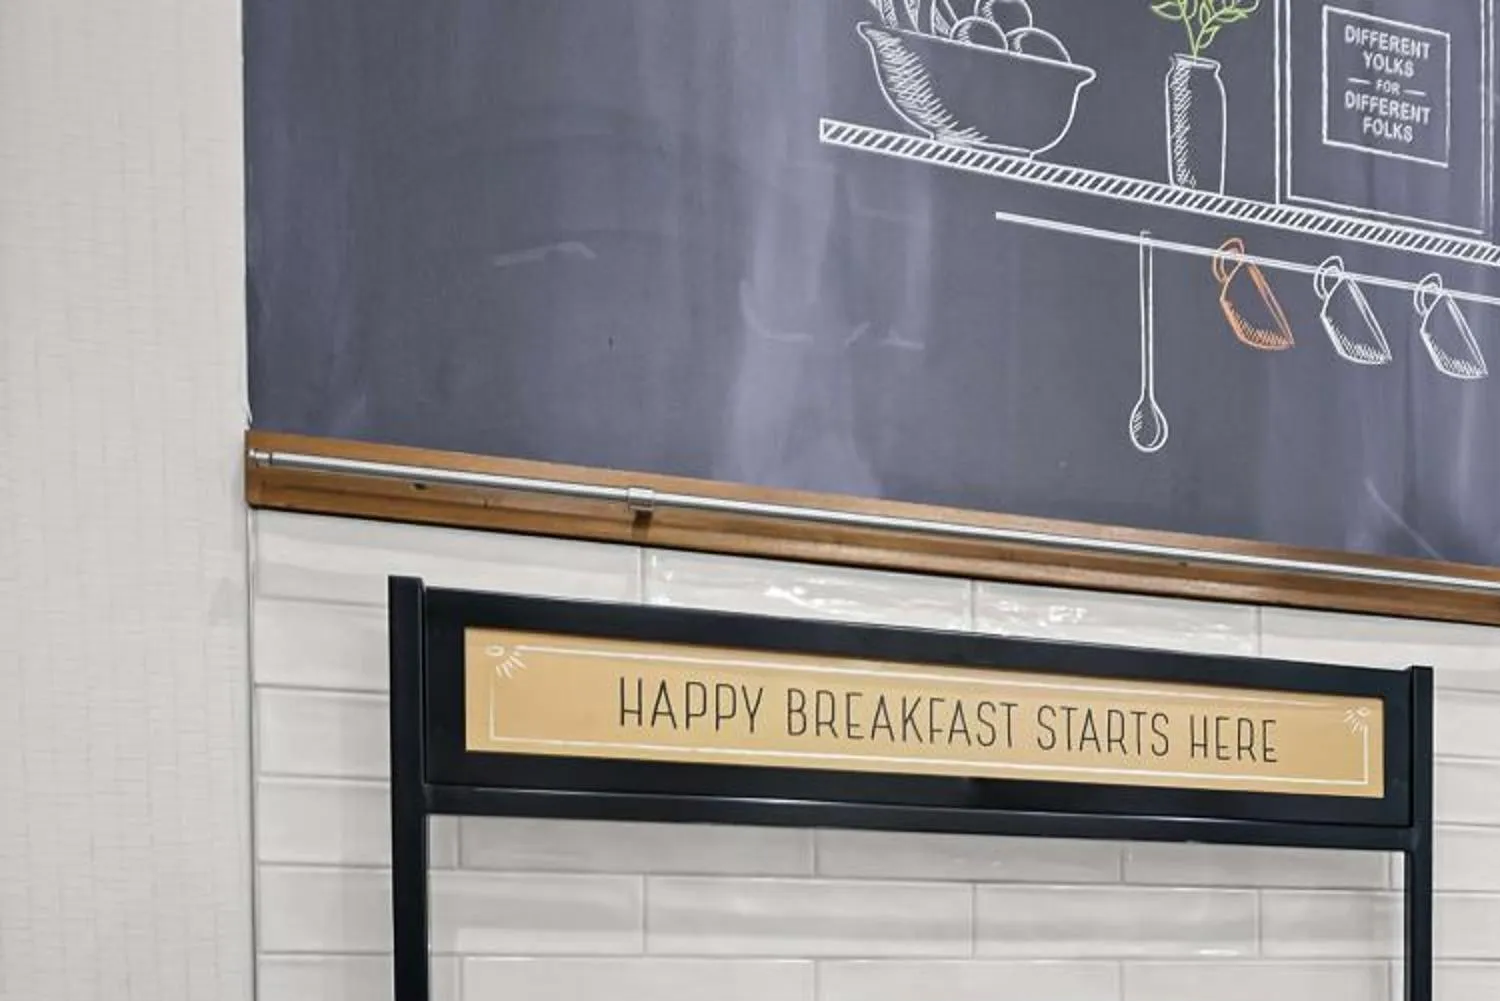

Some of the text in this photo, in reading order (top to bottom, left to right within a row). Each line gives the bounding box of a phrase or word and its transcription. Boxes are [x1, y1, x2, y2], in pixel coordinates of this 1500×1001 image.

[1344, 25, 1430, 59] DIFFERENT
[1363, 51, 1414, 77] YOLKS
[1376, 79, 1400, 96] FOR
[1344, 90, 1431, 125] DIFFERENT
[1363, 116, 1414, 143] FOLKS
[618, 676, 1278, 763] HAPPY BREAKFAST STARTS HERE
